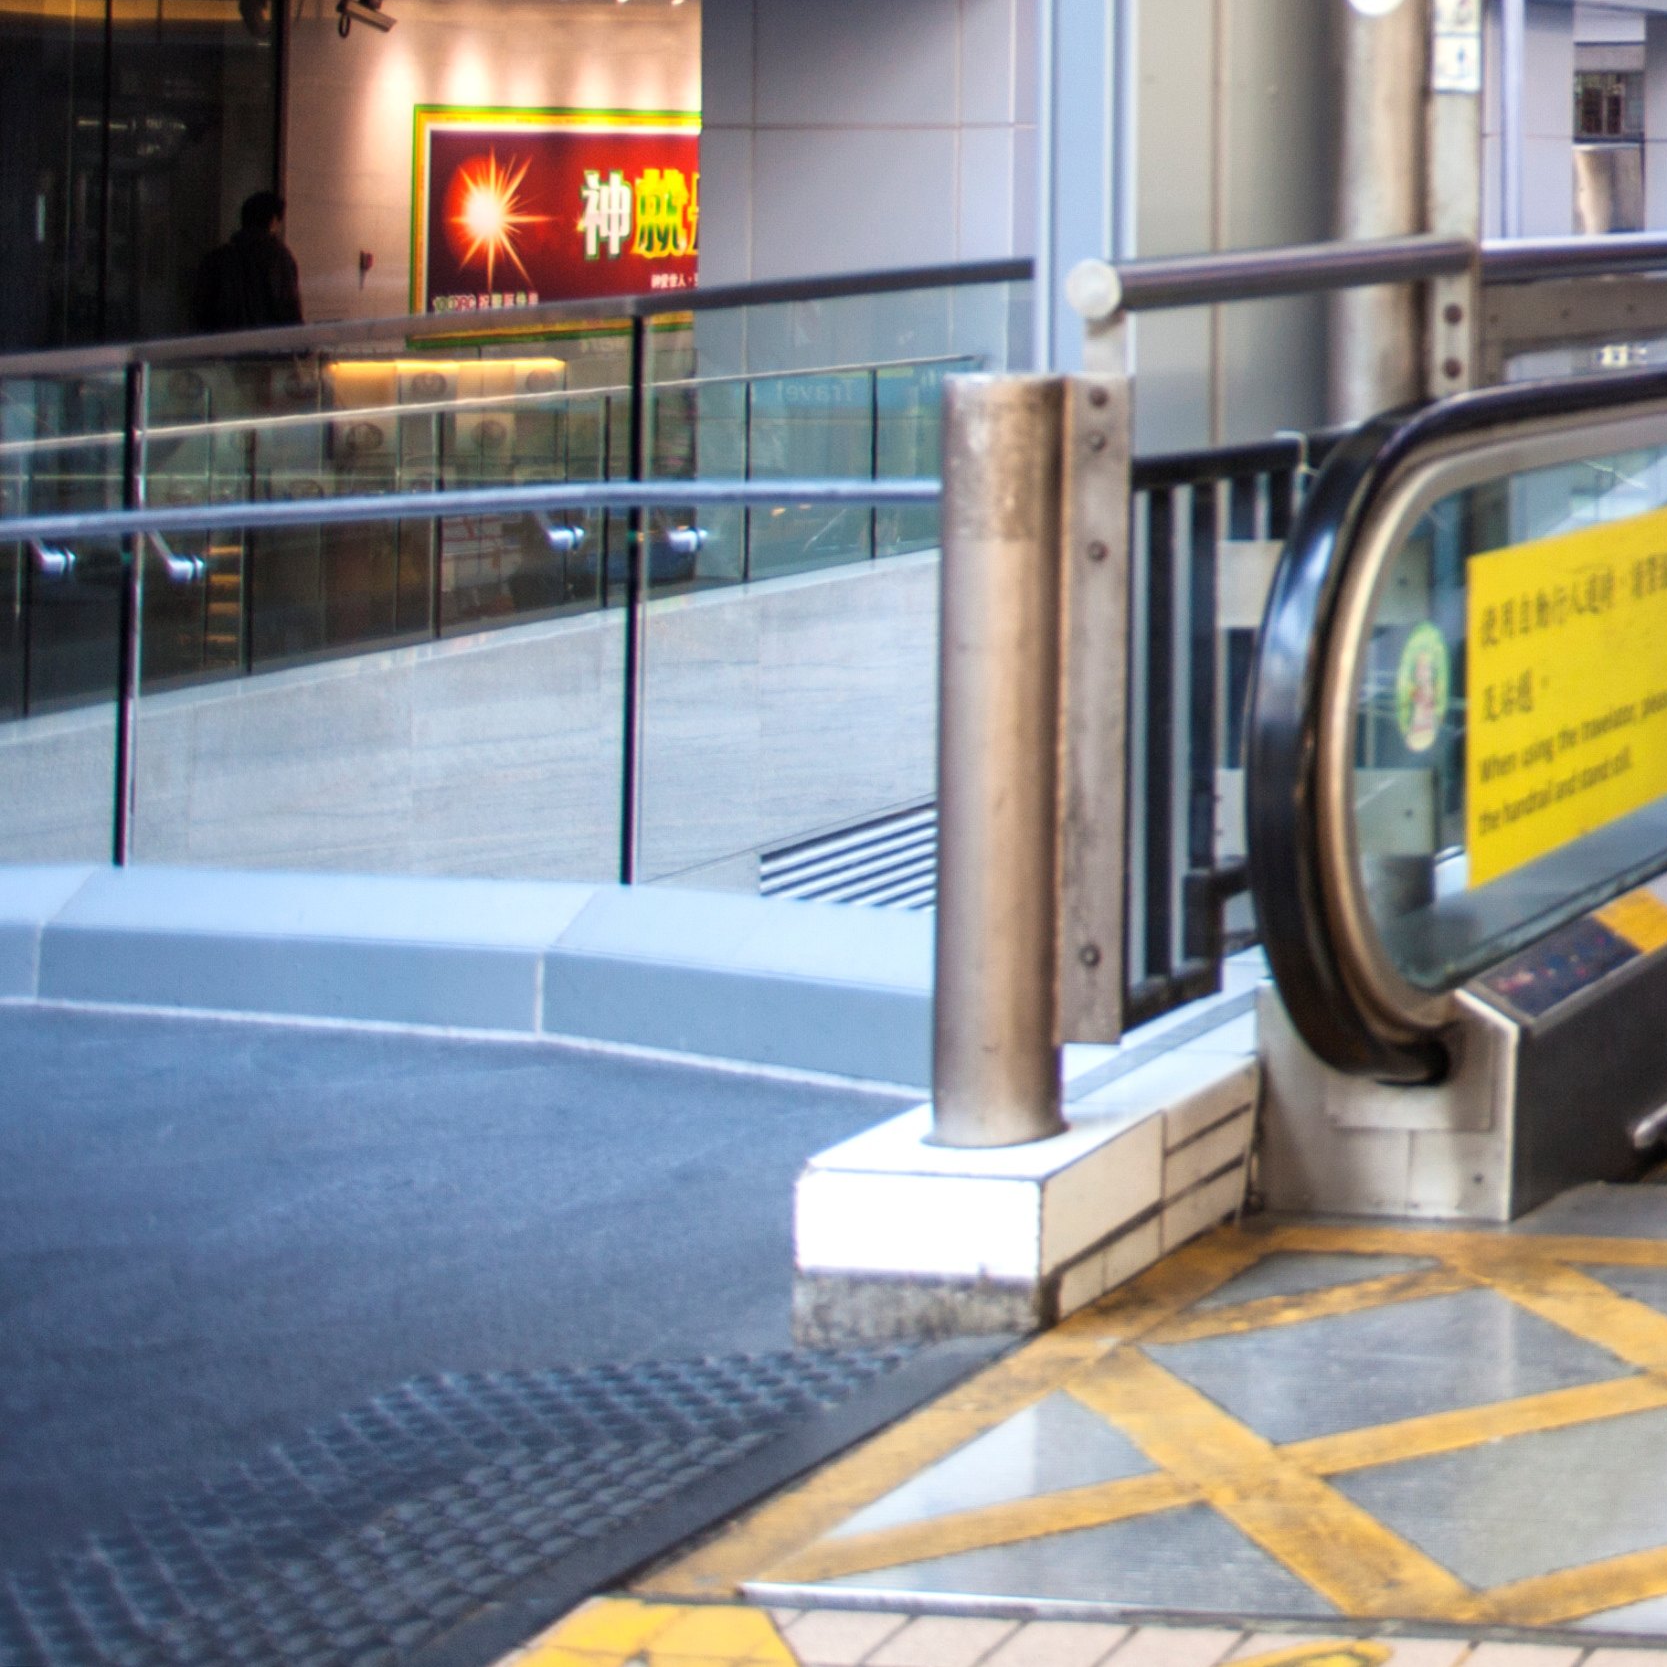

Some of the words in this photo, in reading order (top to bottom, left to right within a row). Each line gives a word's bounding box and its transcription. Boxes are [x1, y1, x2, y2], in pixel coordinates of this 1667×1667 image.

[1480, 752, 1517, 784] When
[1521, 737, 1554, 769] using
[1557, 728, 1578, 751] the
[1480, 808, 1501, 837] the
[1503, 780, 1552, 824] handrail
[1556, 772, 1577, 804] and
[1581, 758, 1609, 790] stand
